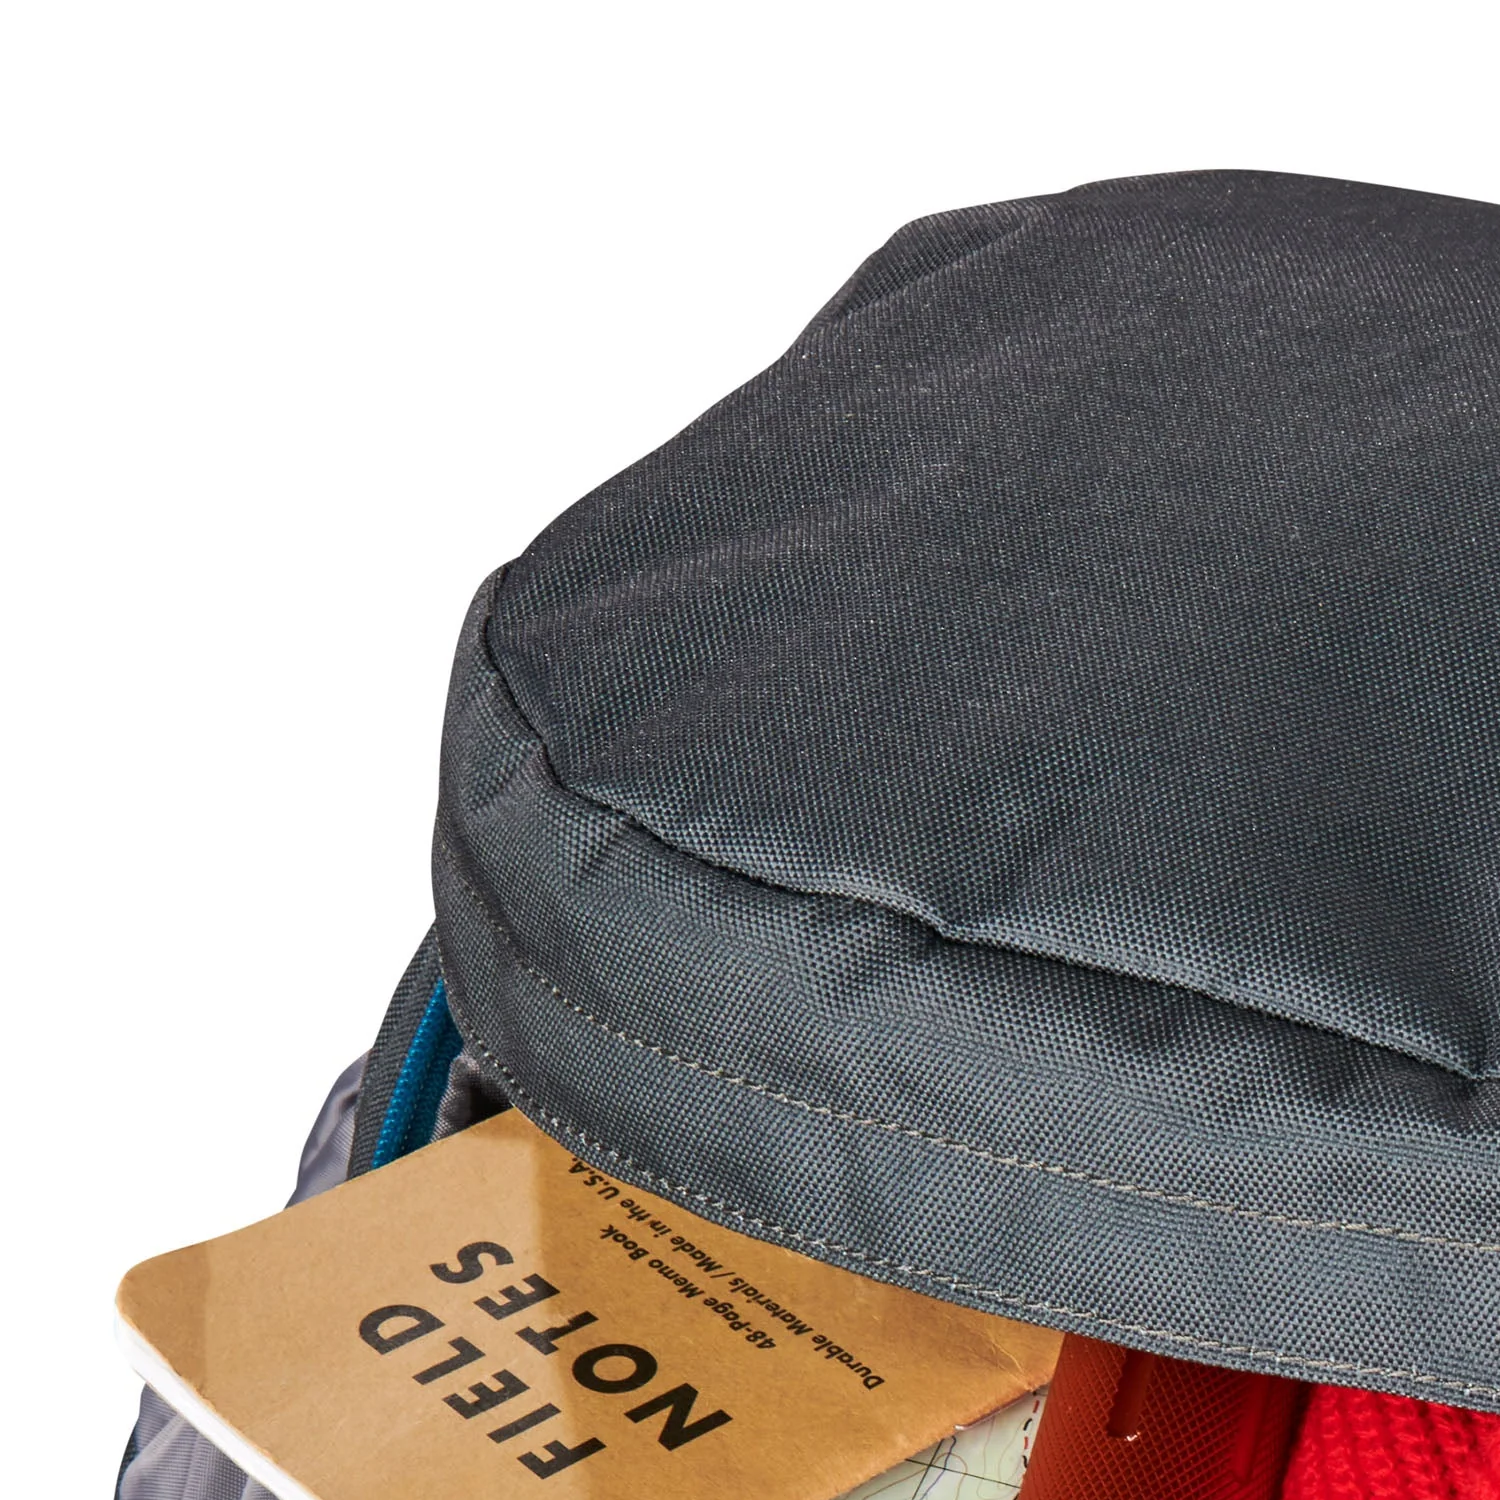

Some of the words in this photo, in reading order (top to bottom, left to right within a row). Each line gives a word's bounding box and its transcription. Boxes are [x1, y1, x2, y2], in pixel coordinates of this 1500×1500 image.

[568, 1156, 620, 1201] U.S.A.
[620, 1198, 650, 1222] the
[648, 1218, 668, 1239] in
[600, 1224, 649, 1261] Book
[670, 1235, 724, 1274] Made
[648, 1258, 704, 1298] Memo
[703, 1296, 776, 1350] 48-Page
[729, 1275, 814, 1336] Materials
[429, 1240, 733, 1451] NOTES
[812, 1333, 885, 1390] Durable
[358, 1303, 607, 1480] FIELD
